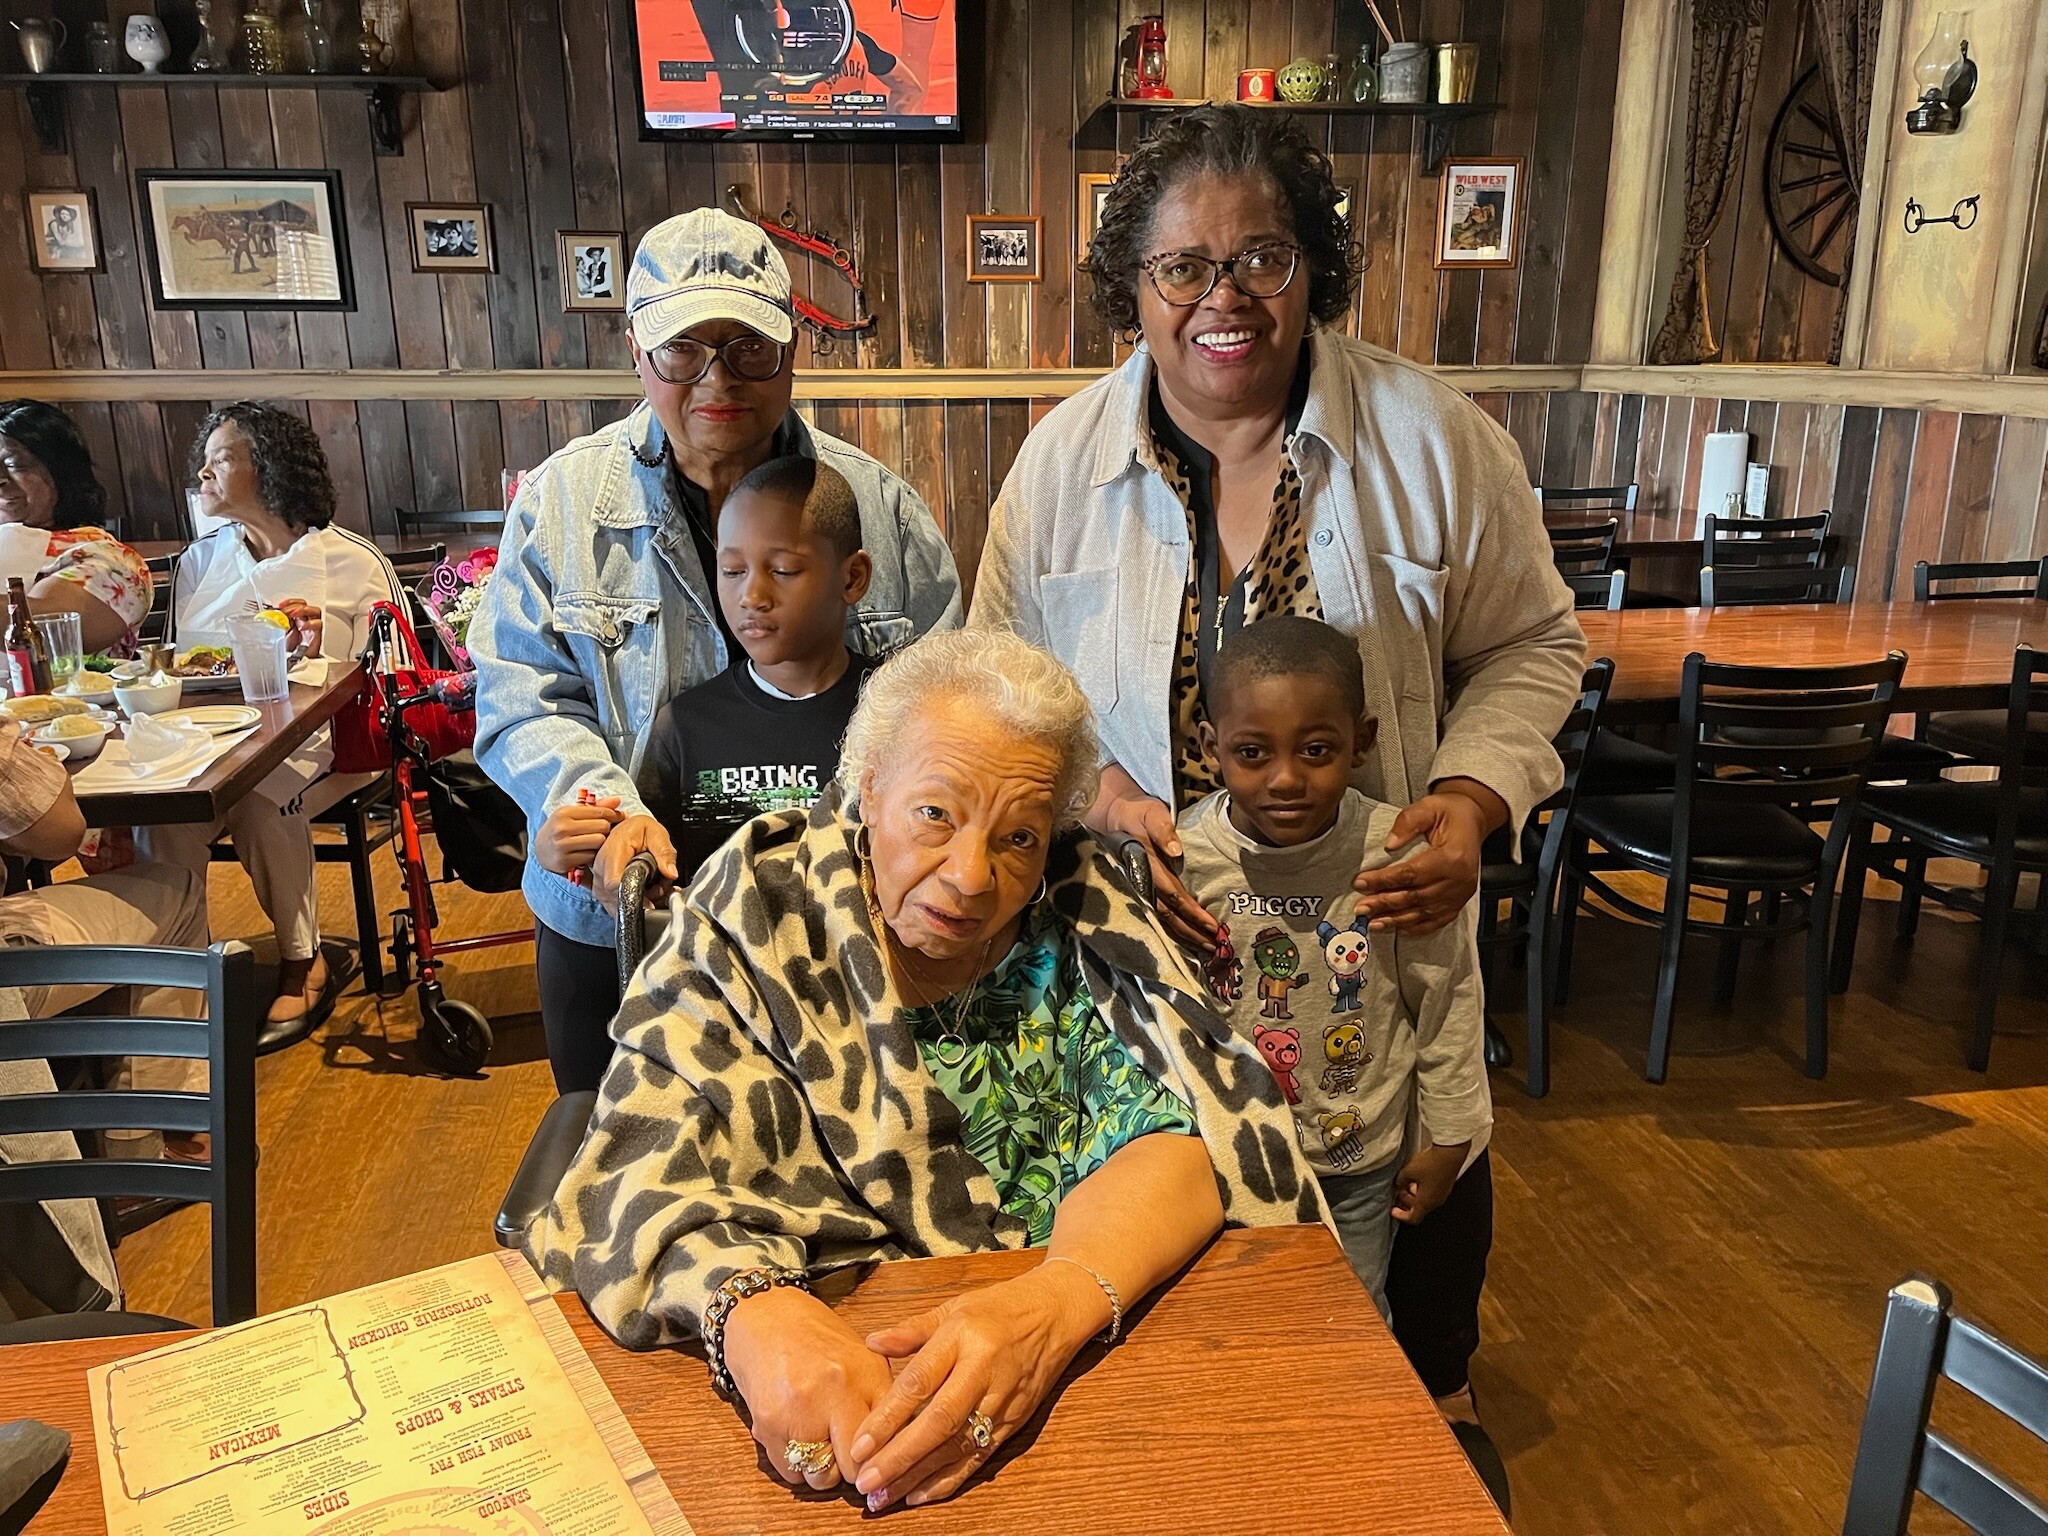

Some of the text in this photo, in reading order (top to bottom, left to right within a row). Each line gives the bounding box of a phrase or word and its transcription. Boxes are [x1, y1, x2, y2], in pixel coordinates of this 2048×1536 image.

[1456, 175, 1507, 185] WILD WEST
[720, 765, 819, 793] BRING
[1228, 892, 1322, 917] PIGGY
[412, 1293, 492, 1326] ROTISSERIE
[346, 1320, 408, 1349] CHICKEN
[395, 1377, 525, 1435] STEAKS & CHOPS
[207, 1423, 281, 1460] MEXICAN
[427, 1427, 531, 1474] FRIDAY FISH FRY
[303, 1490, 349, 1520] SIDES
[477, 1488, 531, 1518] SEAFOOD
